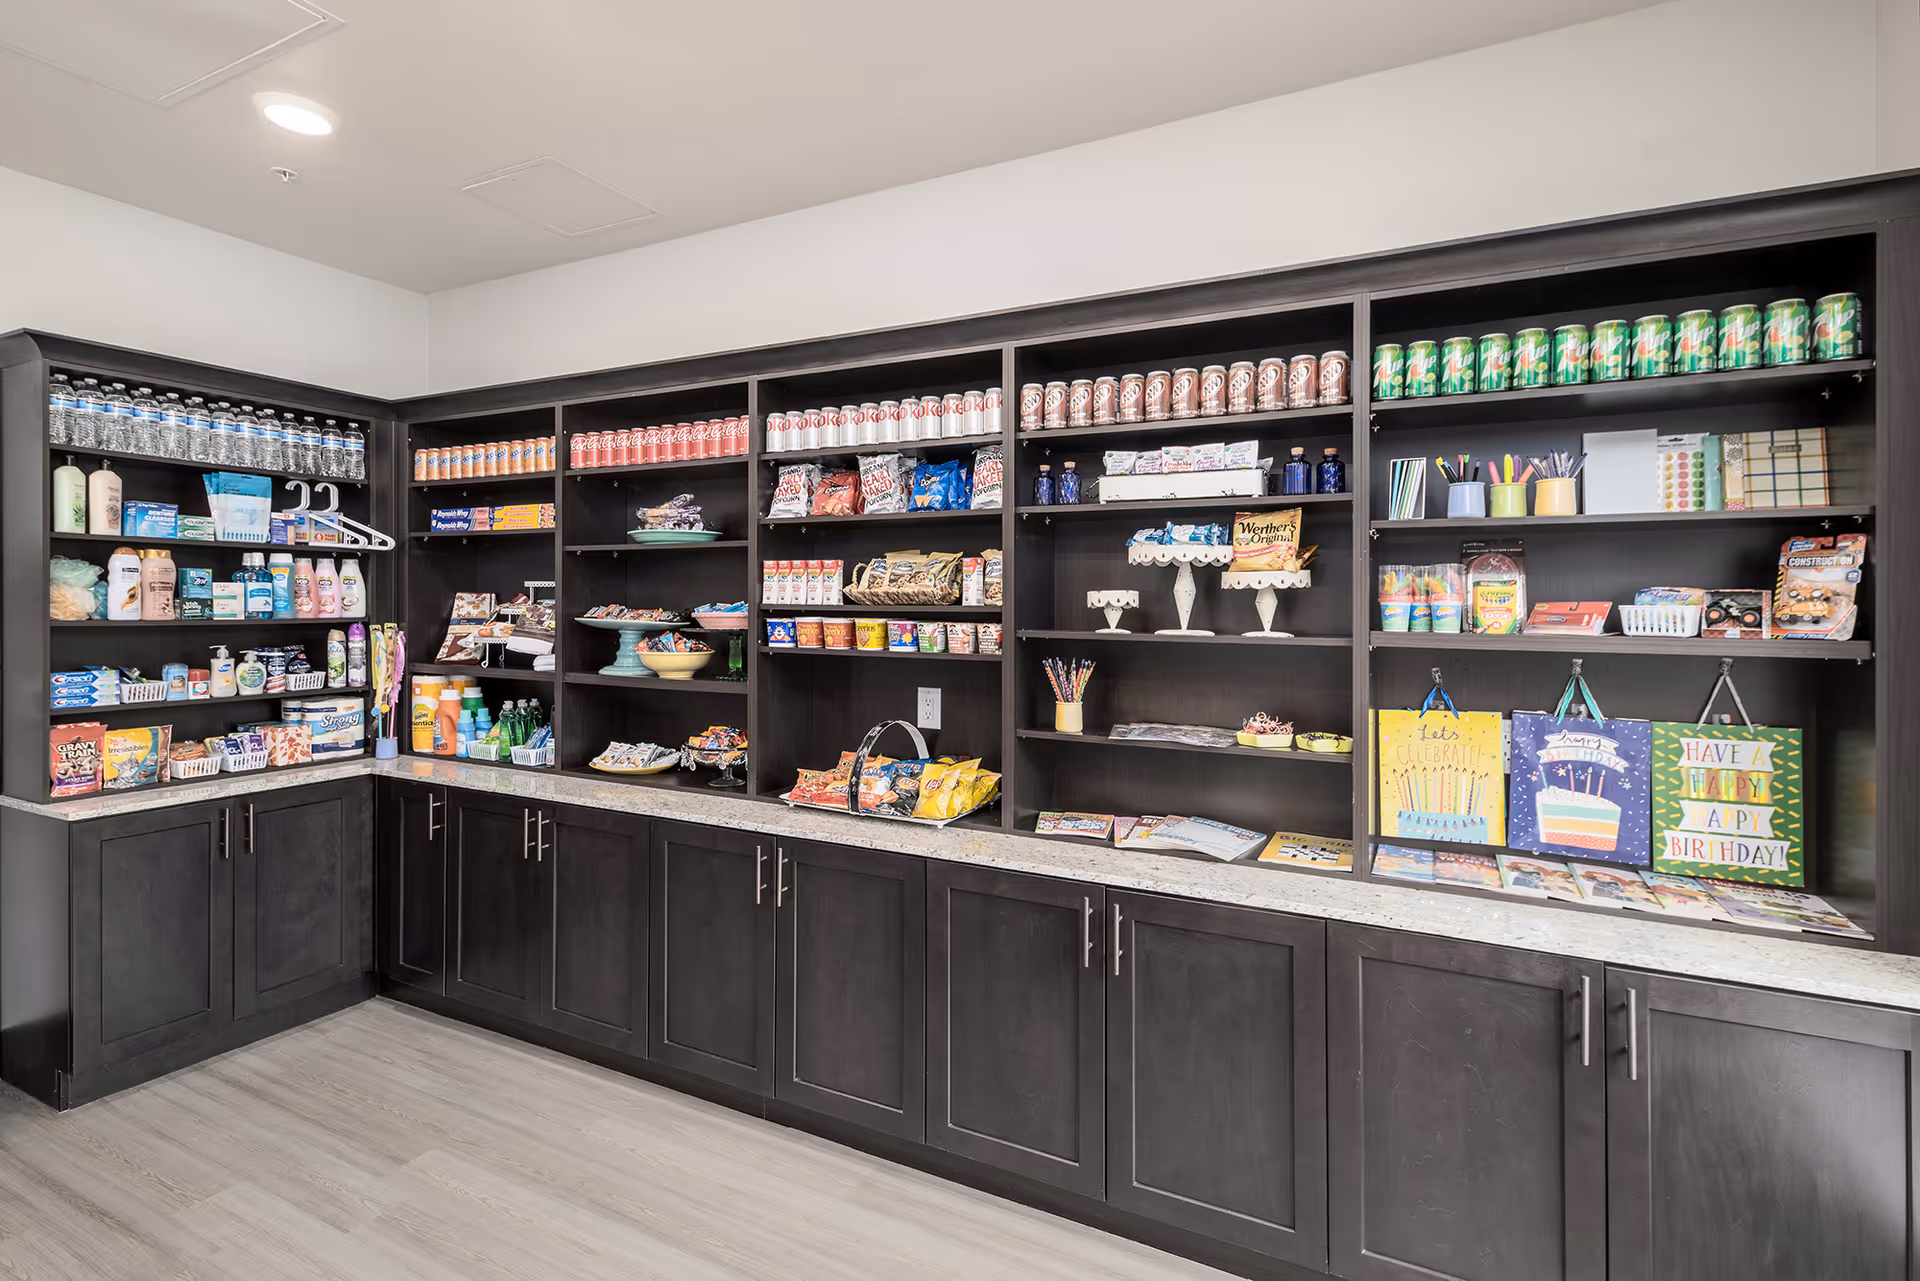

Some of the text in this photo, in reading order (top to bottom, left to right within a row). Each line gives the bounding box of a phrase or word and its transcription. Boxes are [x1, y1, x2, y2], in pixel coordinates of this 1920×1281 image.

[1238, 521, 1297, 534] Werther's
[1251, 530, 1294, 545] Original
[1788, 556, 1854, 567] CONSTRUCTON
[320, 713, 361, 728] Strong
[57, 740, 97, 752] GRAVY
[60, 748, 97, 759] TRAIN
[108, 744, 149, 754] Irresistibles
[1685, 741, 1765, 766] HAVE A
[1396, 743, 1482, 767] CELEBRATE!
[1546, 748, 1628, 769] BIRTHDAY
[1691, 773, 1761, 798] HAPPY
[1691, 805, 1763, 832] HAPPY
[1671, 836, 1785, 868] BIRTHDAY!
